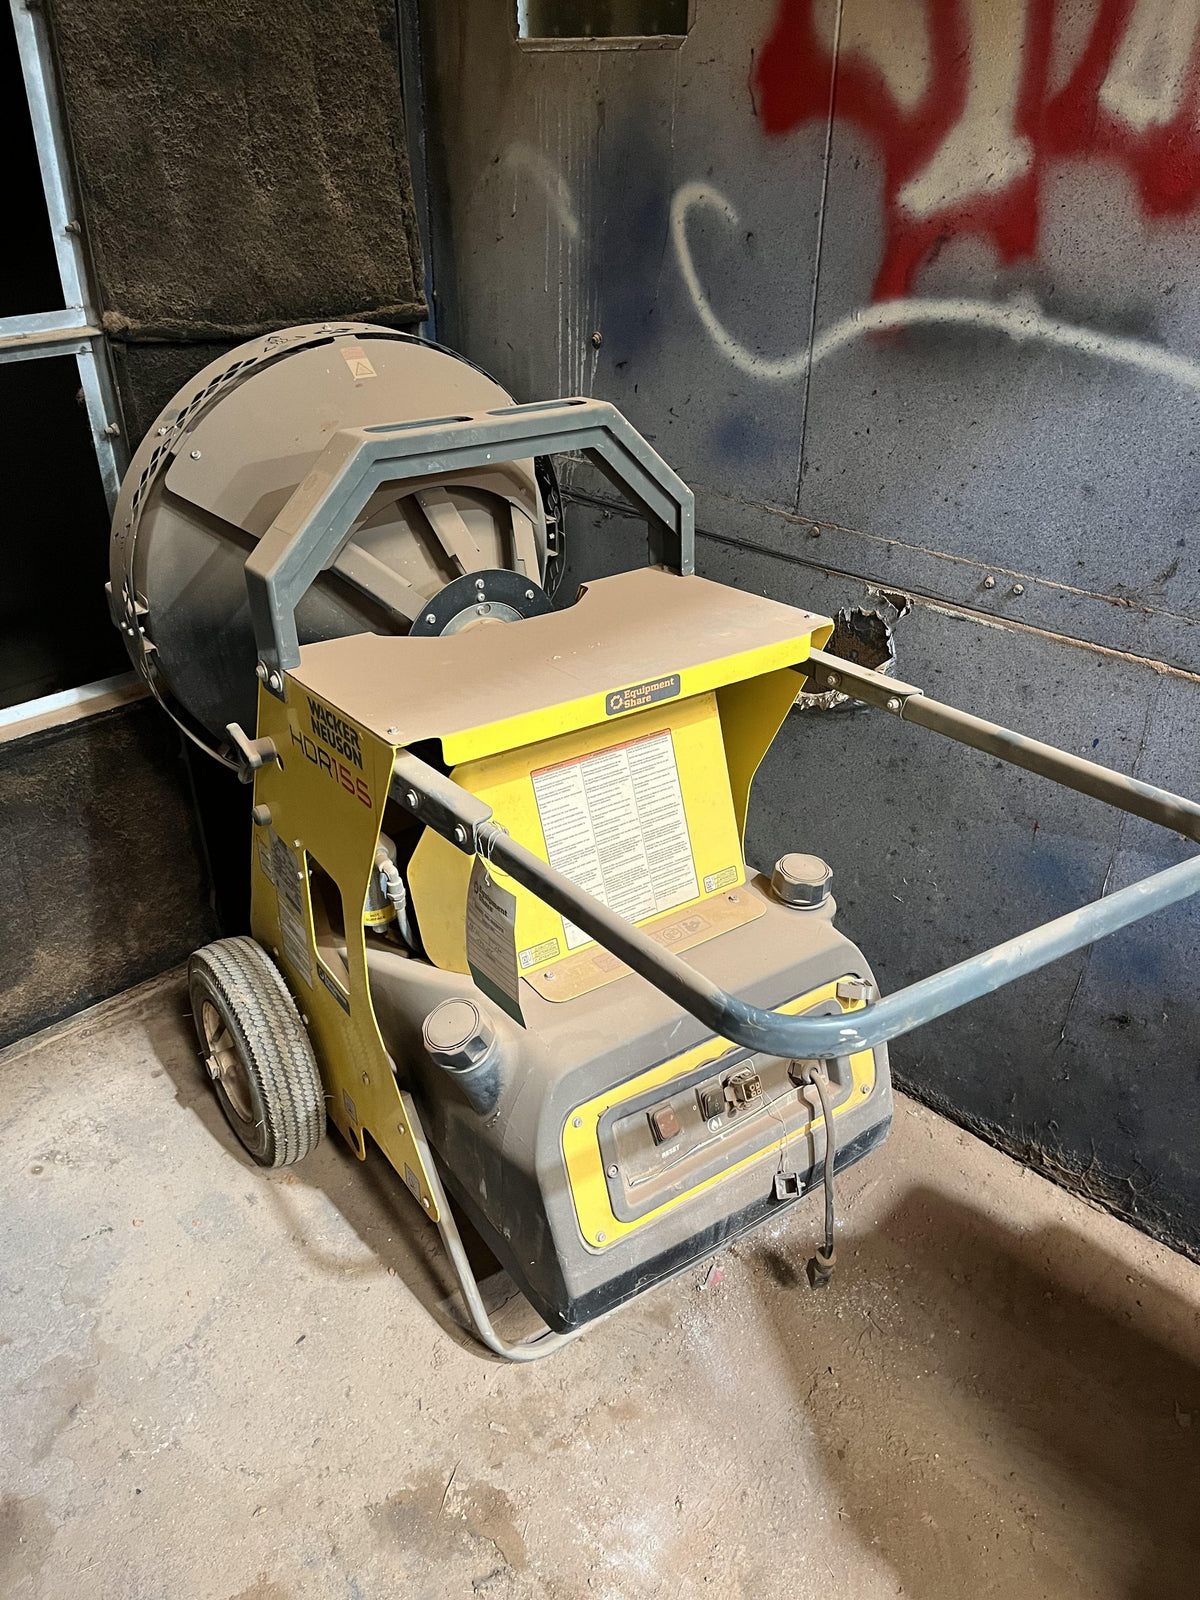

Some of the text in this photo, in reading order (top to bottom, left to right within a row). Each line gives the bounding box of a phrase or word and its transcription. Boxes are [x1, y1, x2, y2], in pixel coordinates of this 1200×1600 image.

[624, 677, 675, 699] Equipment
[624, 694, 652, 709] Share
[307, 695, 361, 751] WACKER
[311, 715, 363, 770] NEUSON
[289, 723, 372, 809] HDR155
[661, 1143, 680, 1159] RESET
